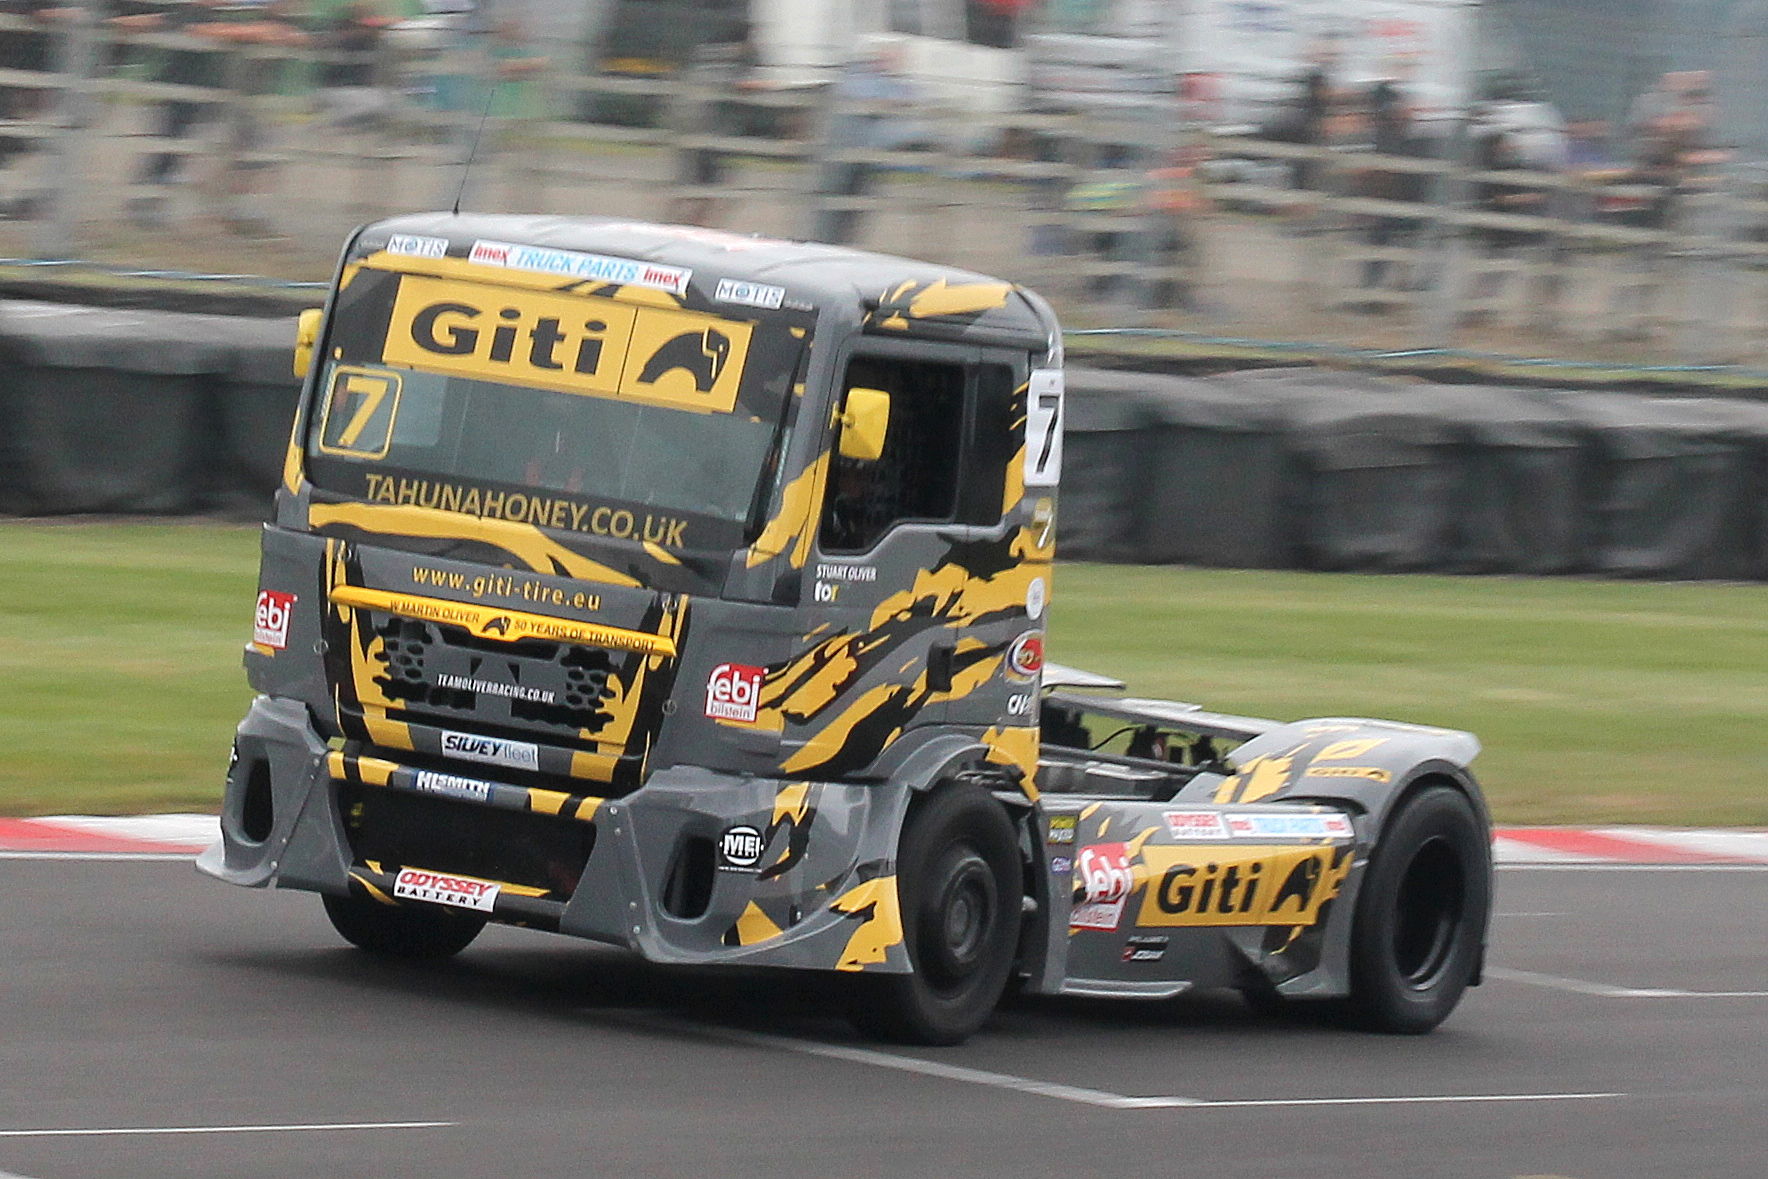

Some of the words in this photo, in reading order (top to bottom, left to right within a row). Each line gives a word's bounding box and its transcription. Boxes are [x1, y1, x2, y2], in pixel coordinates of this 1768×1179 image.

[516, 250, 573, 274] TRUCK
[576, 261, 638, 282] PARTS
[410, 302, 608, 376] Giti
[338, 375, 389, 446] 7
[1036, 393, 1061, 474] 7
[364, 473, 689, 549] TAHUNAHONEY.CO.UK
[411, 566, 603, 612] www.giti-tire.eu
[401, 601, 441, 618] MARTIN
[442, 607, 480, 624] OLIVER
[530, 621, 567, 637] YEARS
[569, 628, 584, 640] OF
[588, 632, 656, 651] TRANSPORT
[437, 673, 555, 704] TEAMOLIVERRACING.CO.UK
[705, 663, 770, 714] febi
[397, 887, 481, 907] BATTERY
[401, 871, 492, 896] ODYSSEY
[1157, 862, 1262, 915] Giti
